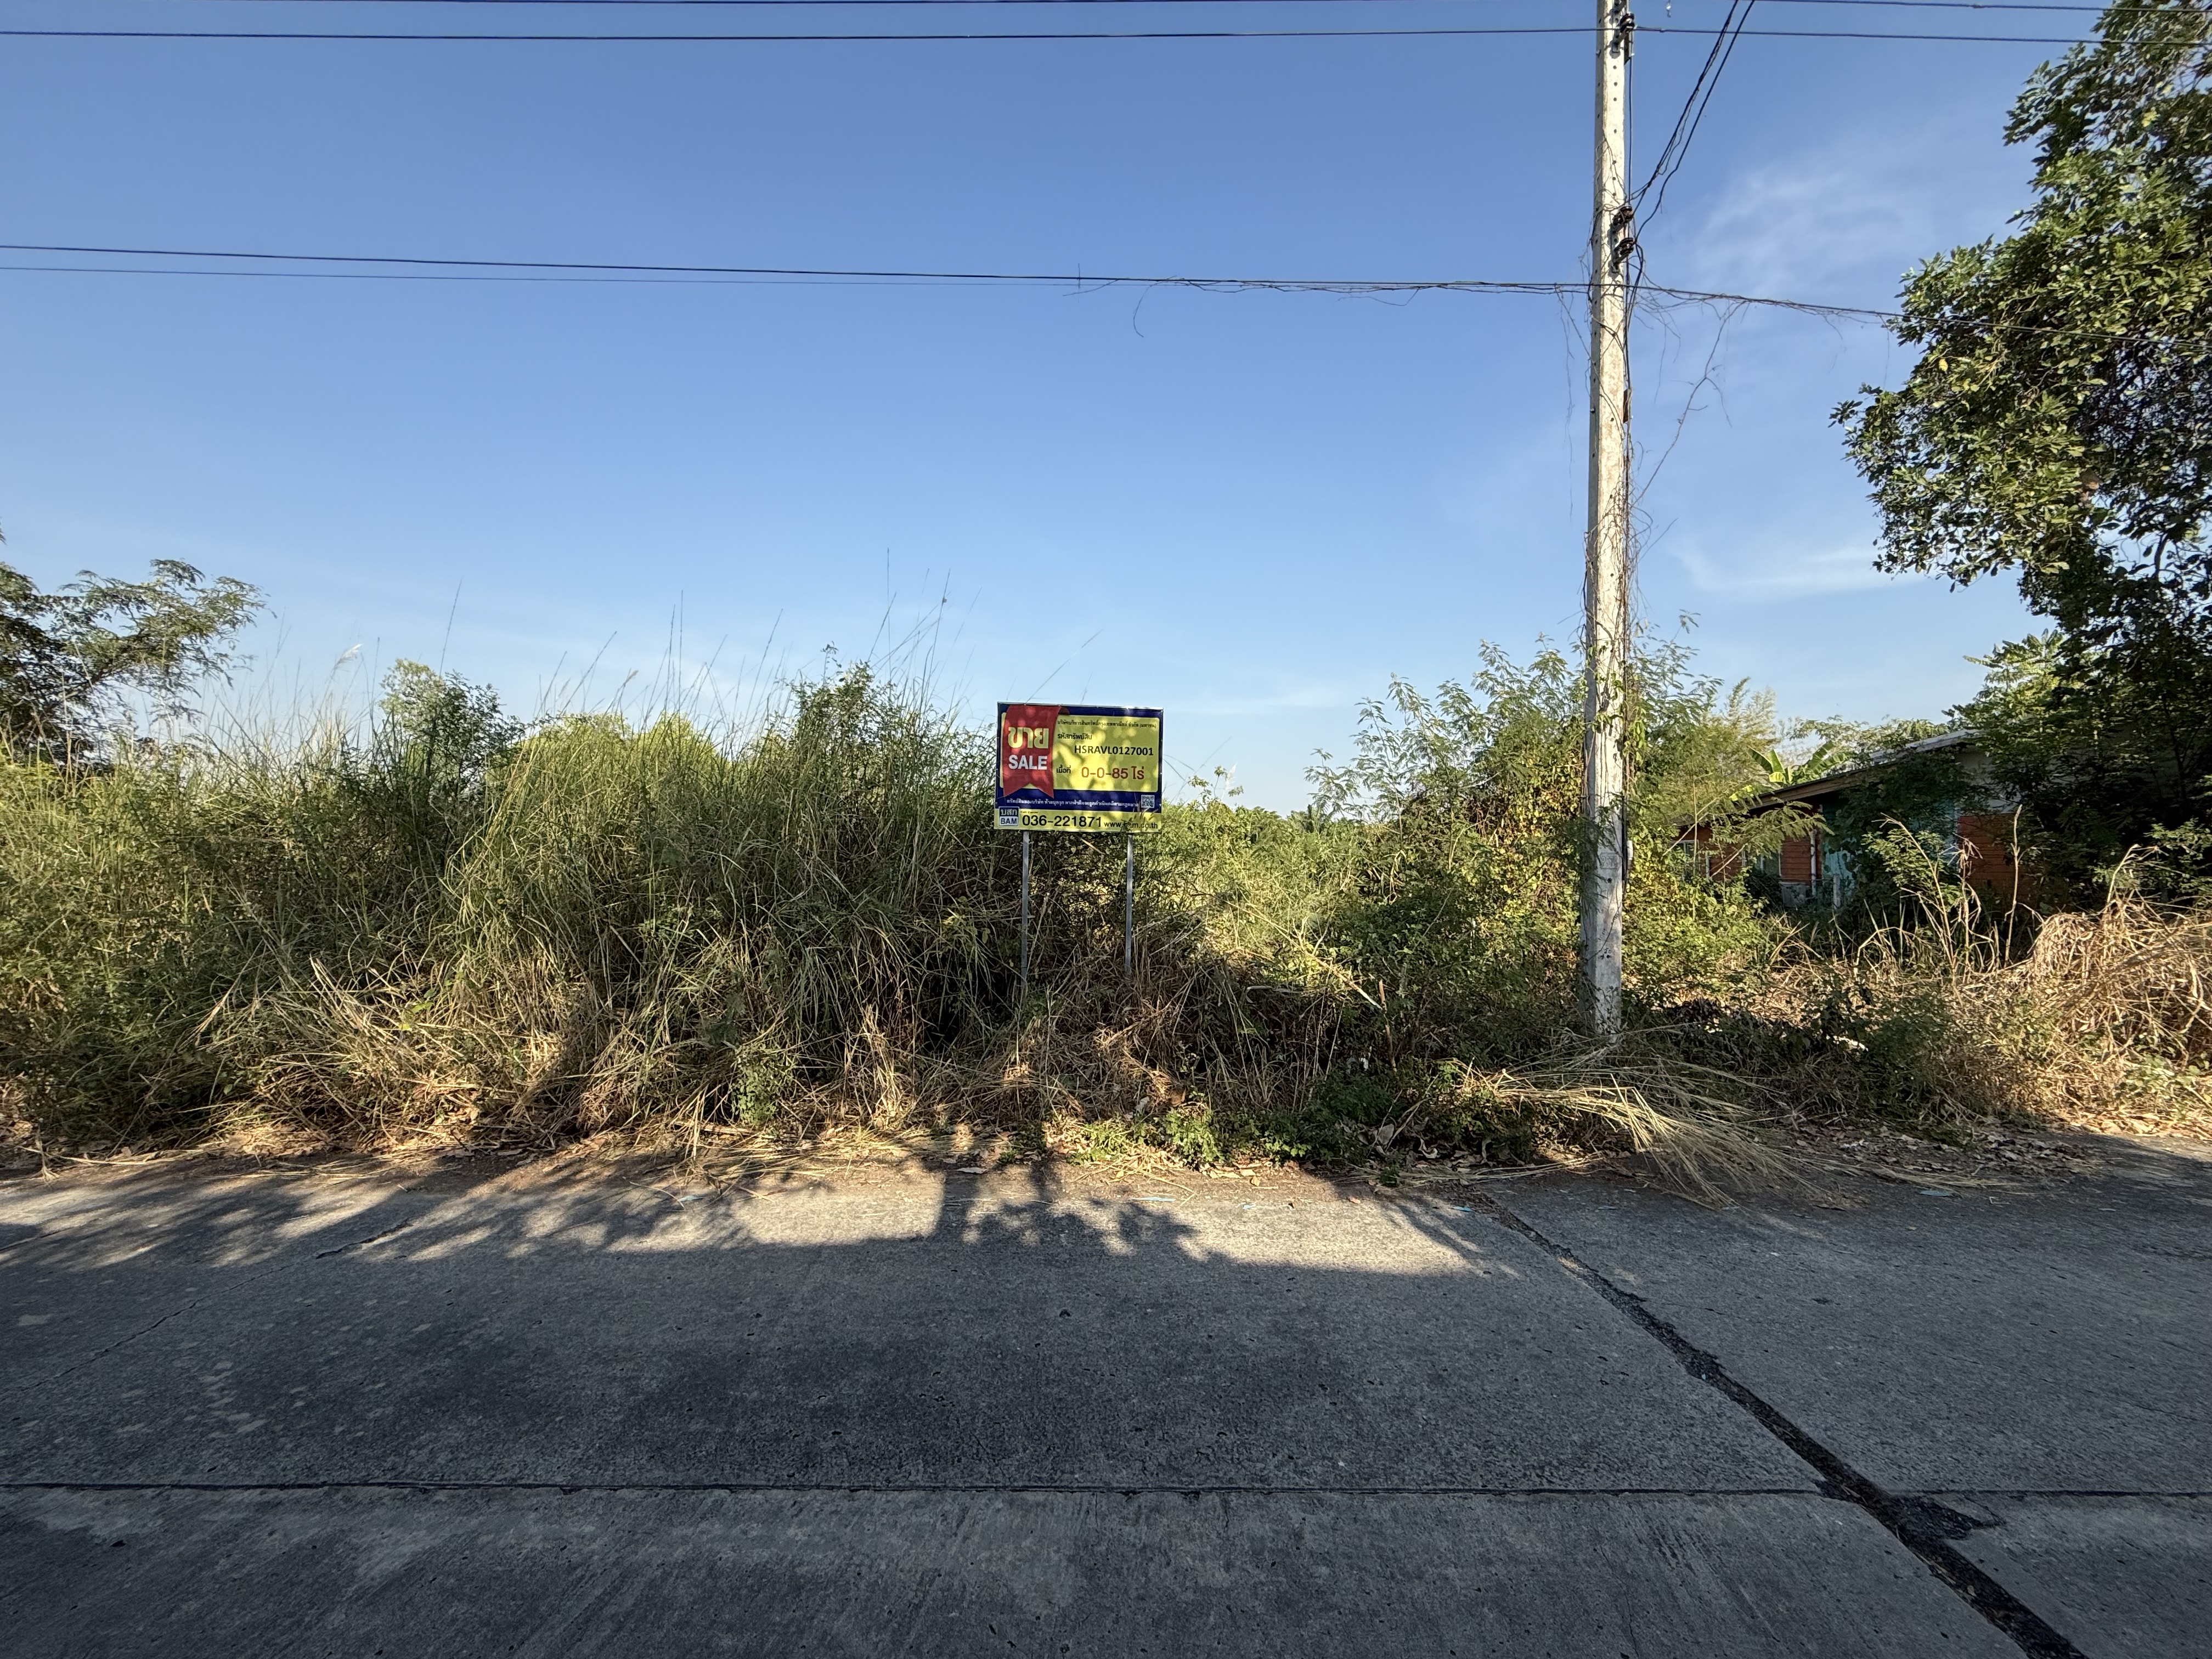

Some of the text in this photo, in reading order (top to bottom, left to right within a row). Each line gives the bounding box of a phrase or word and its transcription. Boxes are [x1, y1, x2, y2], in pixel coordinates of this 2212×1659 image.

[1008, 726, 1049, 749] ขาย
[1074, 745, 1154, 756] HSRAVL0127001
[1008, 755, 1047, 770] SALE
[1056, 765, 1144, 780] เนื้อที่ 0-0-85 ไร่
[1022, 815, 1101, 827] 036-221871
